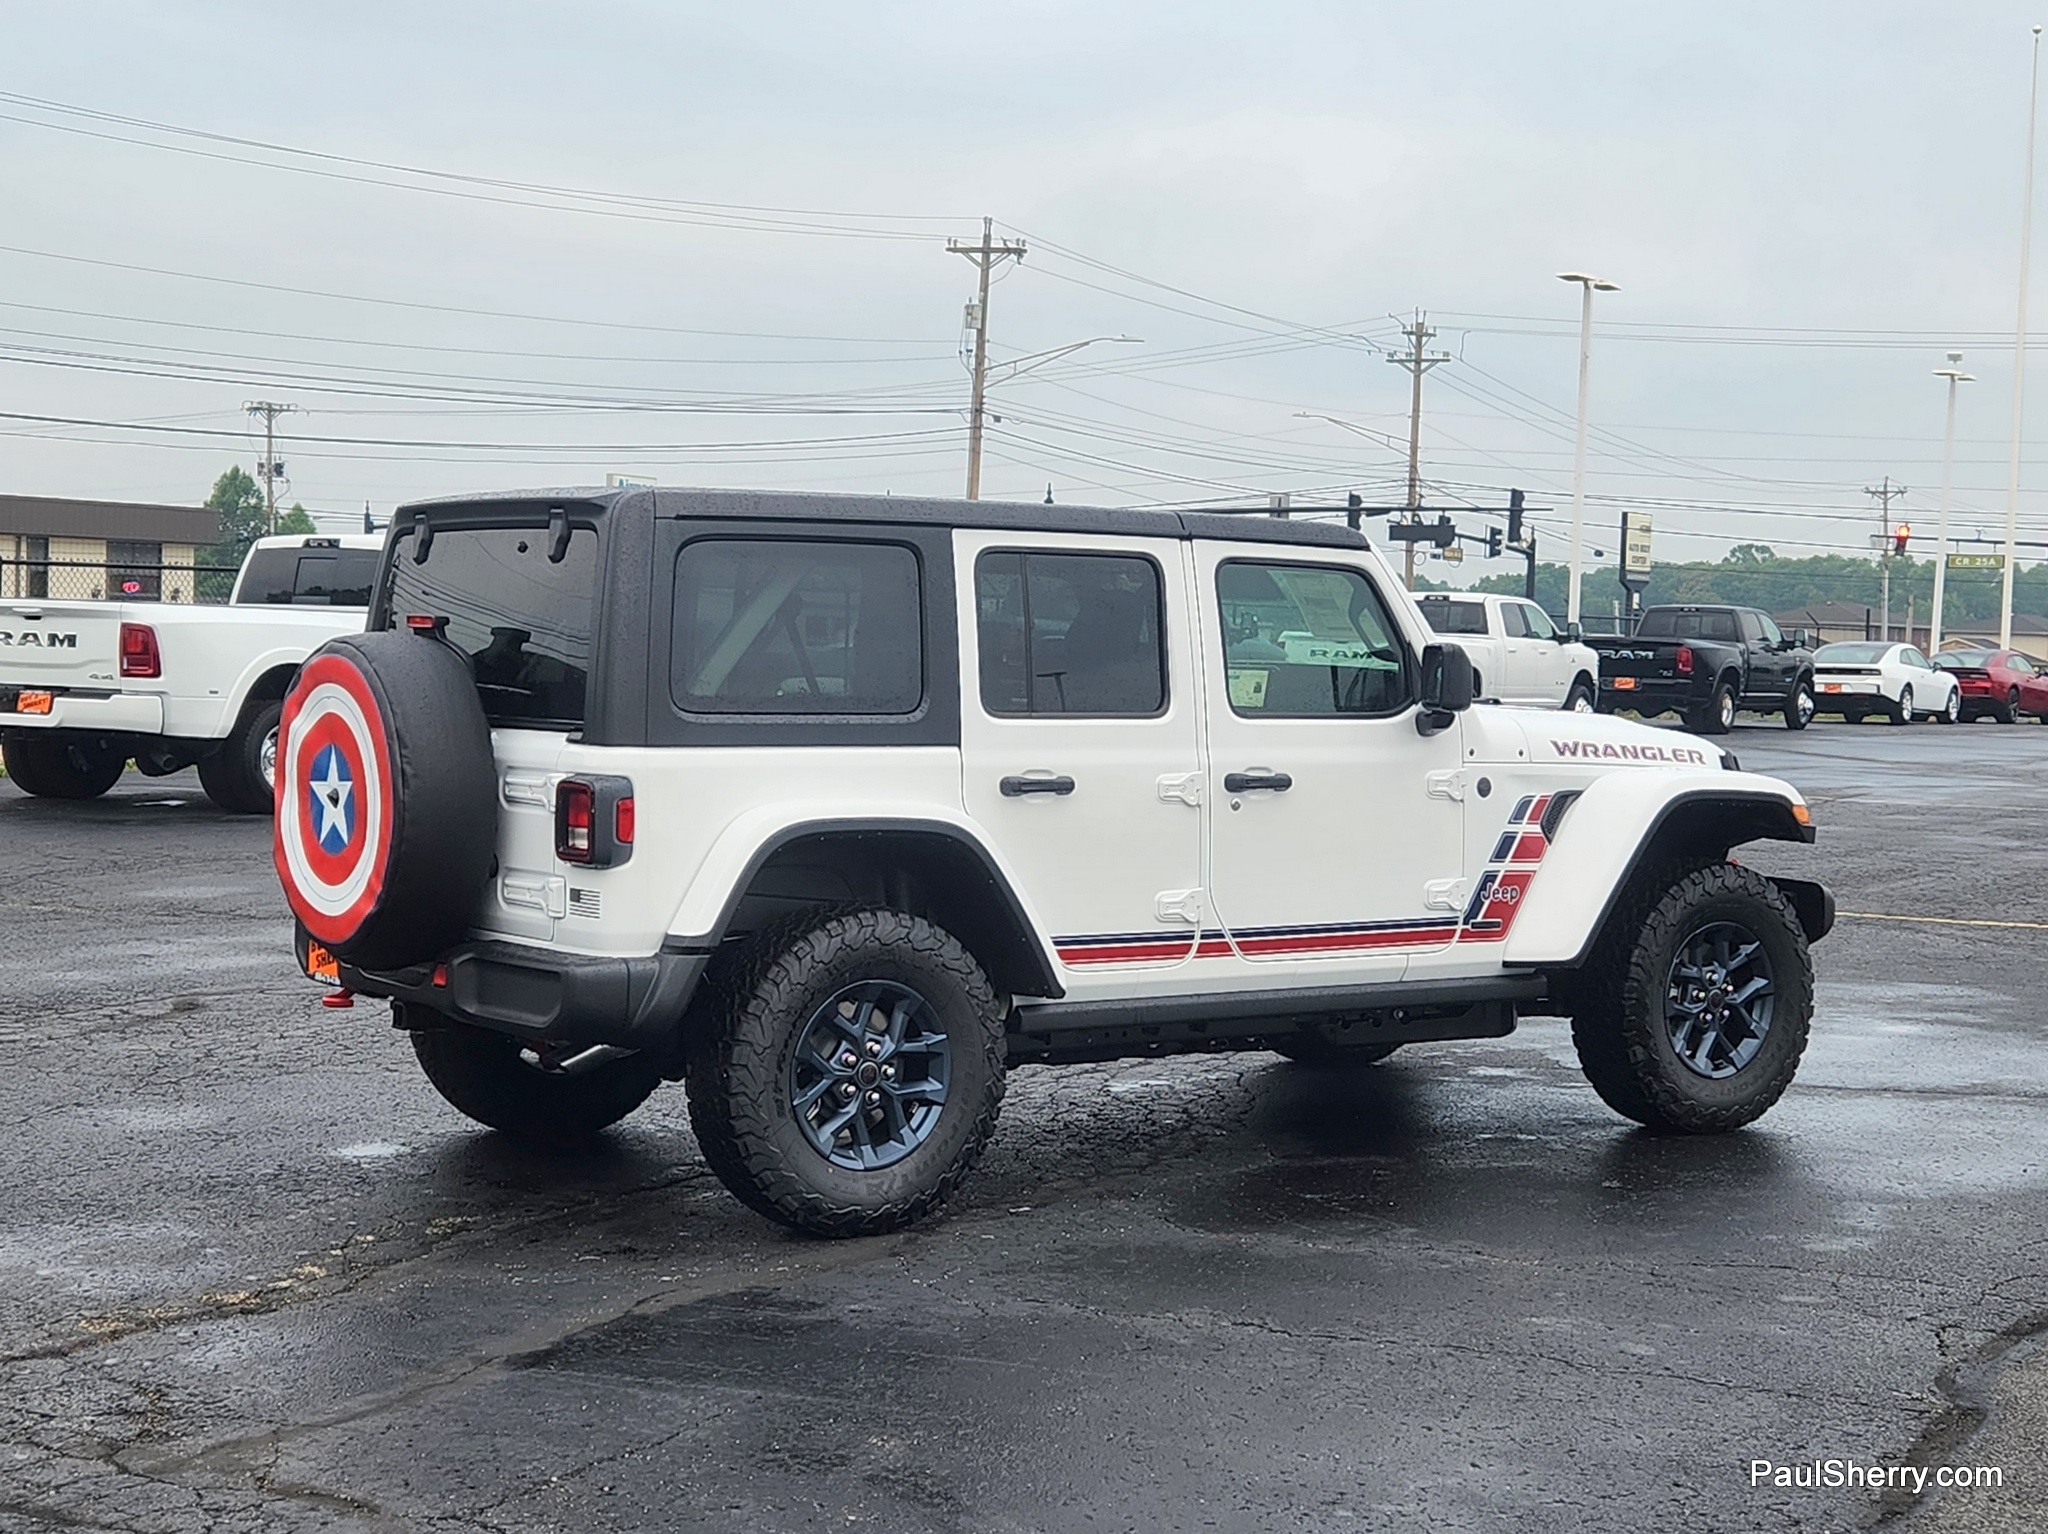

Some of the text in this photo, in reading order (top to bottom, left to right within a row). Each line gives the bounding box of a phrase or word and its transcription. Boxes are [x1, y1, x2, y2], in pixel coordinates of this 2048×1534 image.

[1955, 557, 1996, 566] CR 25A
[1598, 650, 1655, 660] RAM
[1550, 740, 1707, 765] WRANGLER
[1481, 883, 1519, 904] Jeep
